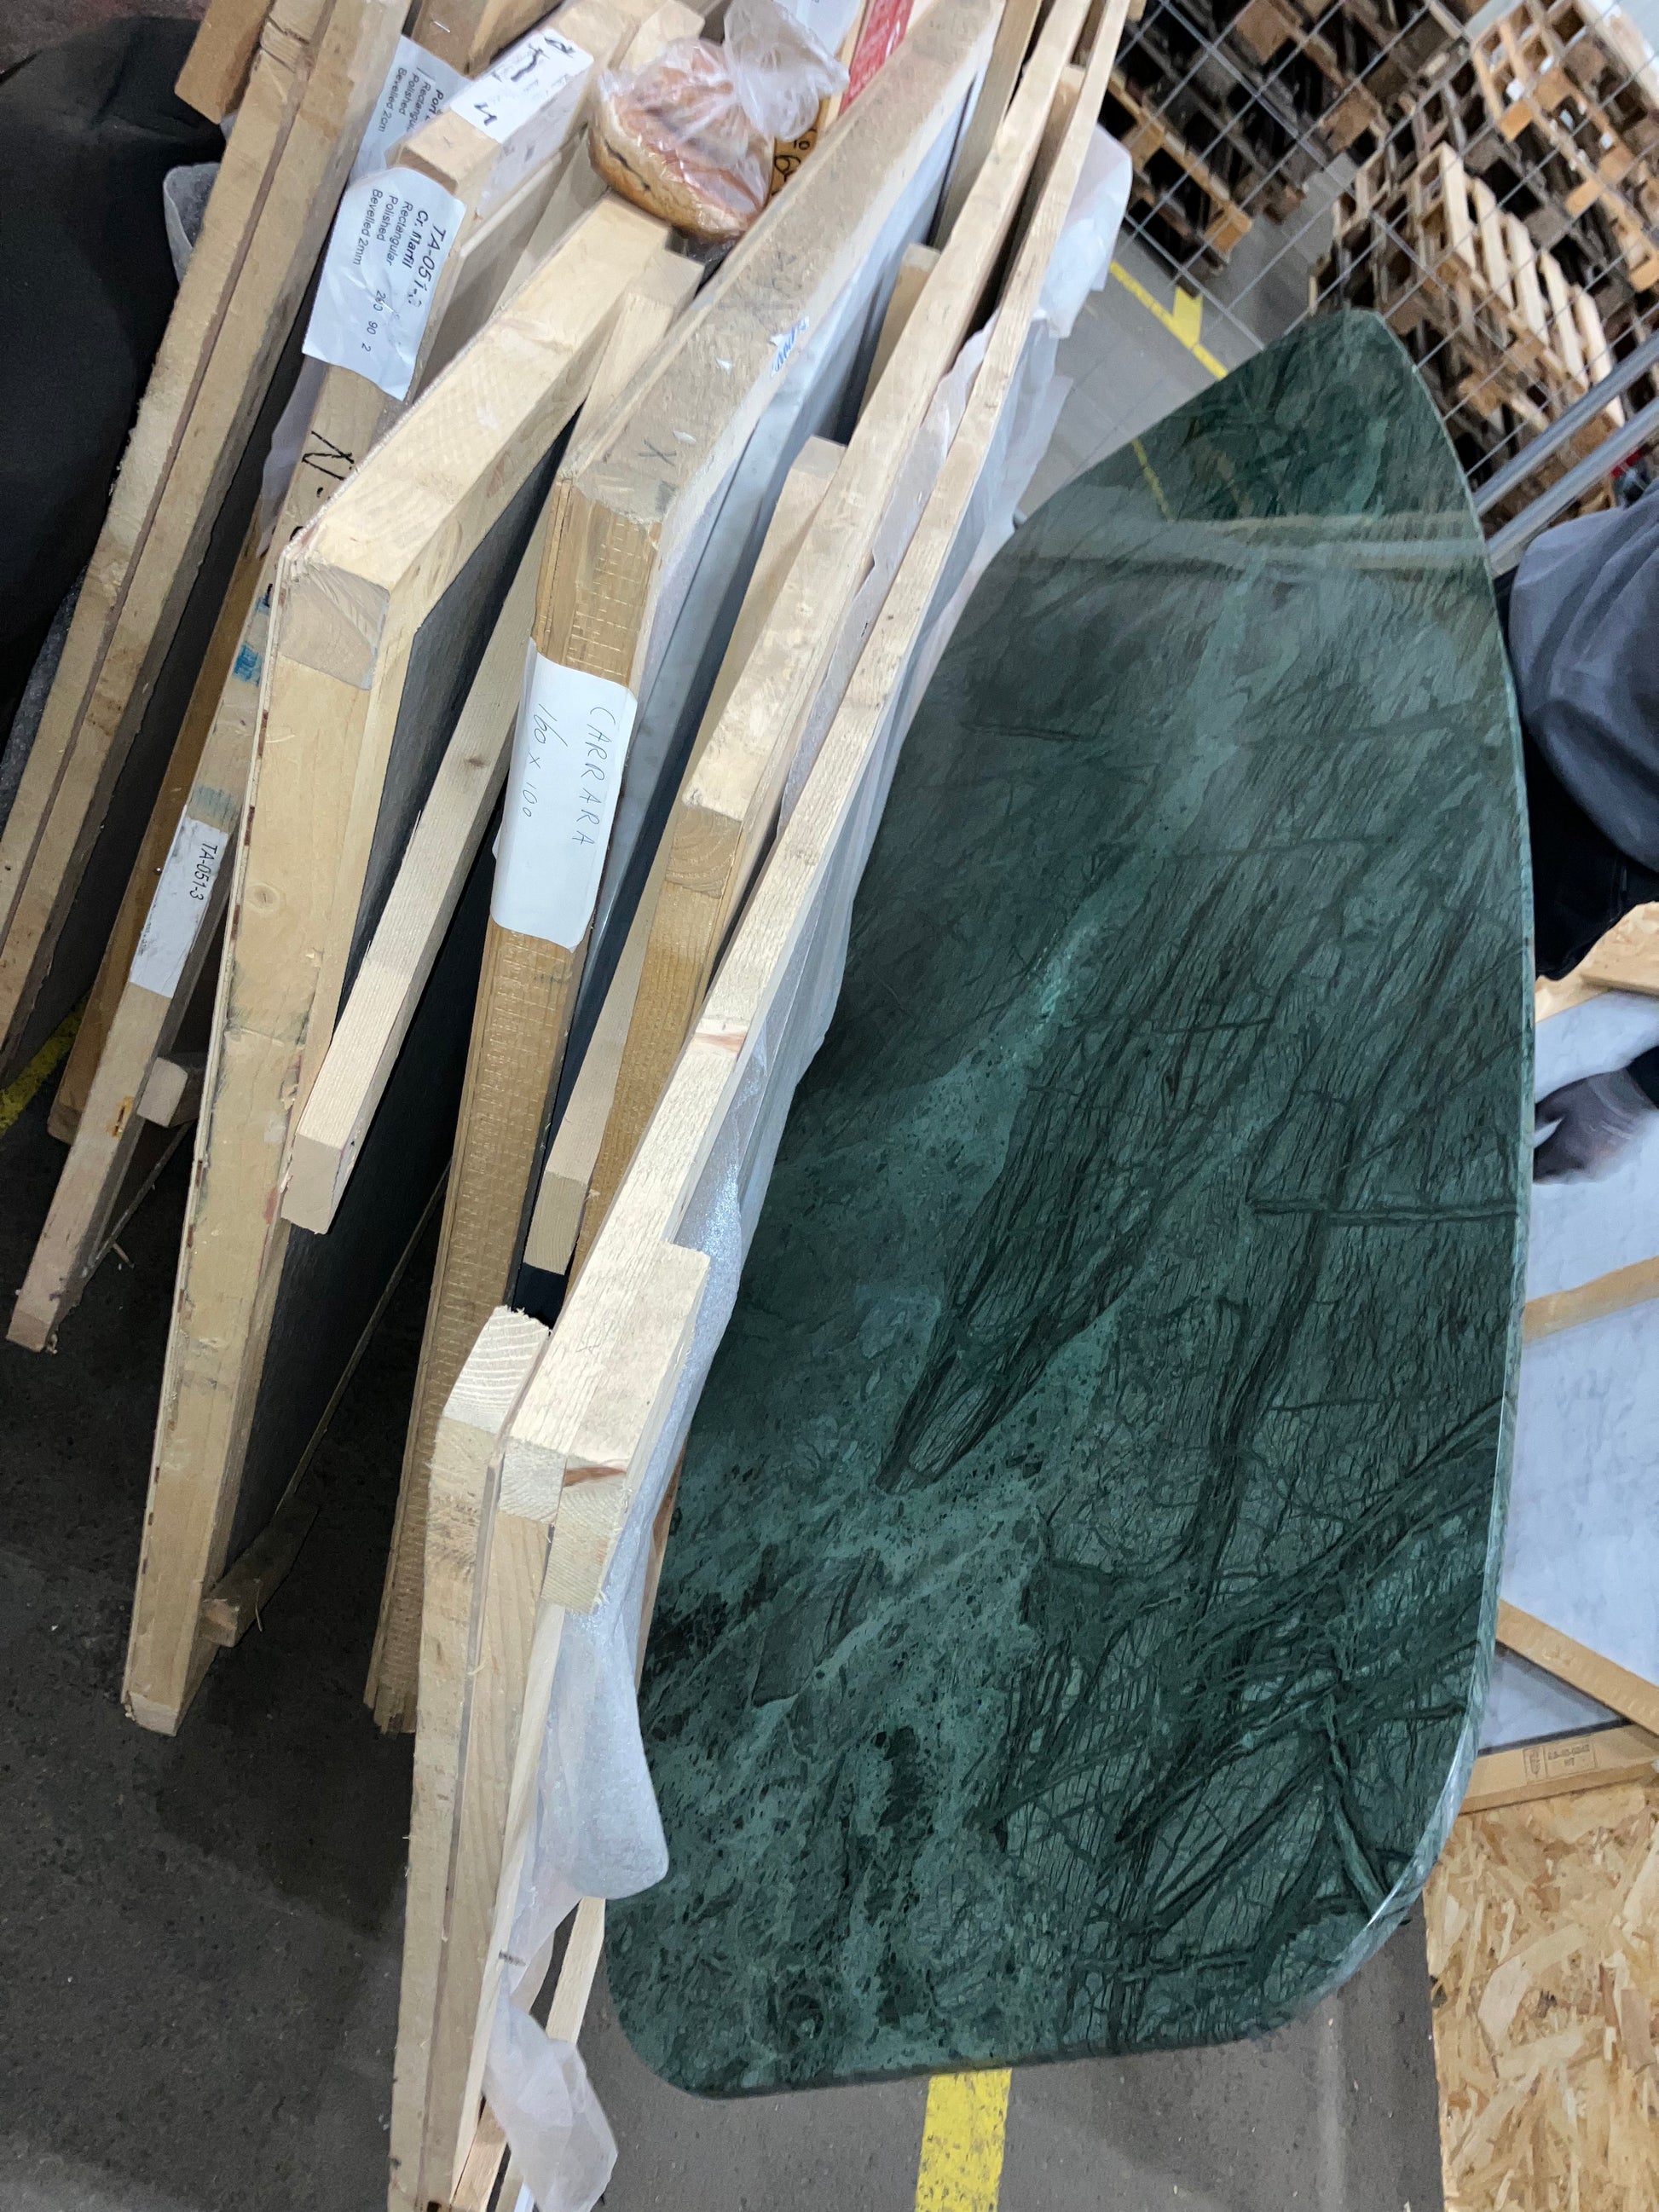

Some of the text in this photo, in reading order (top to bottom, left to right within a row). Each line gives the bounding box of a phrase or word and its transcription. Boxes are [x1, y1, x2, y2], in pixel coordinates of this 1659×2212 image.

[377, 67, 408, 134] Bevelled 2cm
[398, 72, 420, 117] Polished
[407, 81, 431, 133] Rectangul
[352, 188, 384, 266] Bevelled 2mm
[376, 194, 399, 242] Polished
[388, 200, 414, 267] Rectangular
[402, 210, 430, 269] Cr. Marfil
[367, 321, 379, 335] 90
[534, 703, 569, 748] 160
[522, 782, 538, 817] 100
[571, 707, 616, 845] CARRARA
[188, 842, 218, 901] TA-051-3
